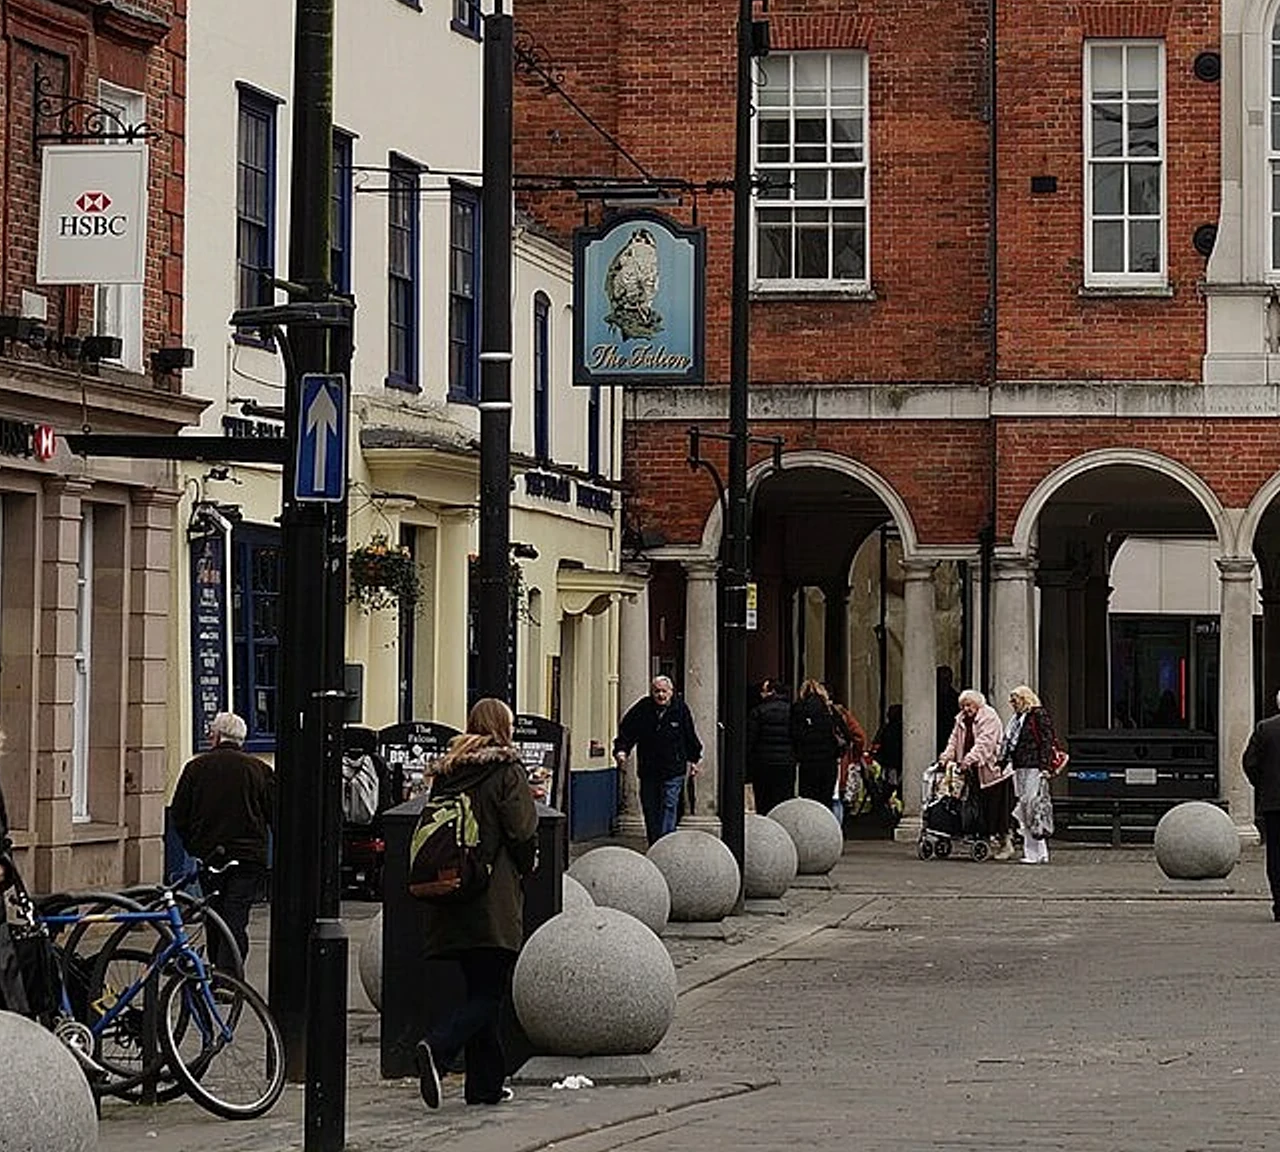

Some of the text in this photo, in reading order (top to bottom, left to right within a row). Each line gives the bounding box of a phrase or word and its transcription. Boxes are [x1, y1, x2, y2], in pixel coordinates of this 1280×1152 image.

[60, 215, 127, 236] HSBC
[591, 344, 691, 369] The Falcon
[415, 724, 431, 734] The
[407, 734, 437, 743] Falcon
